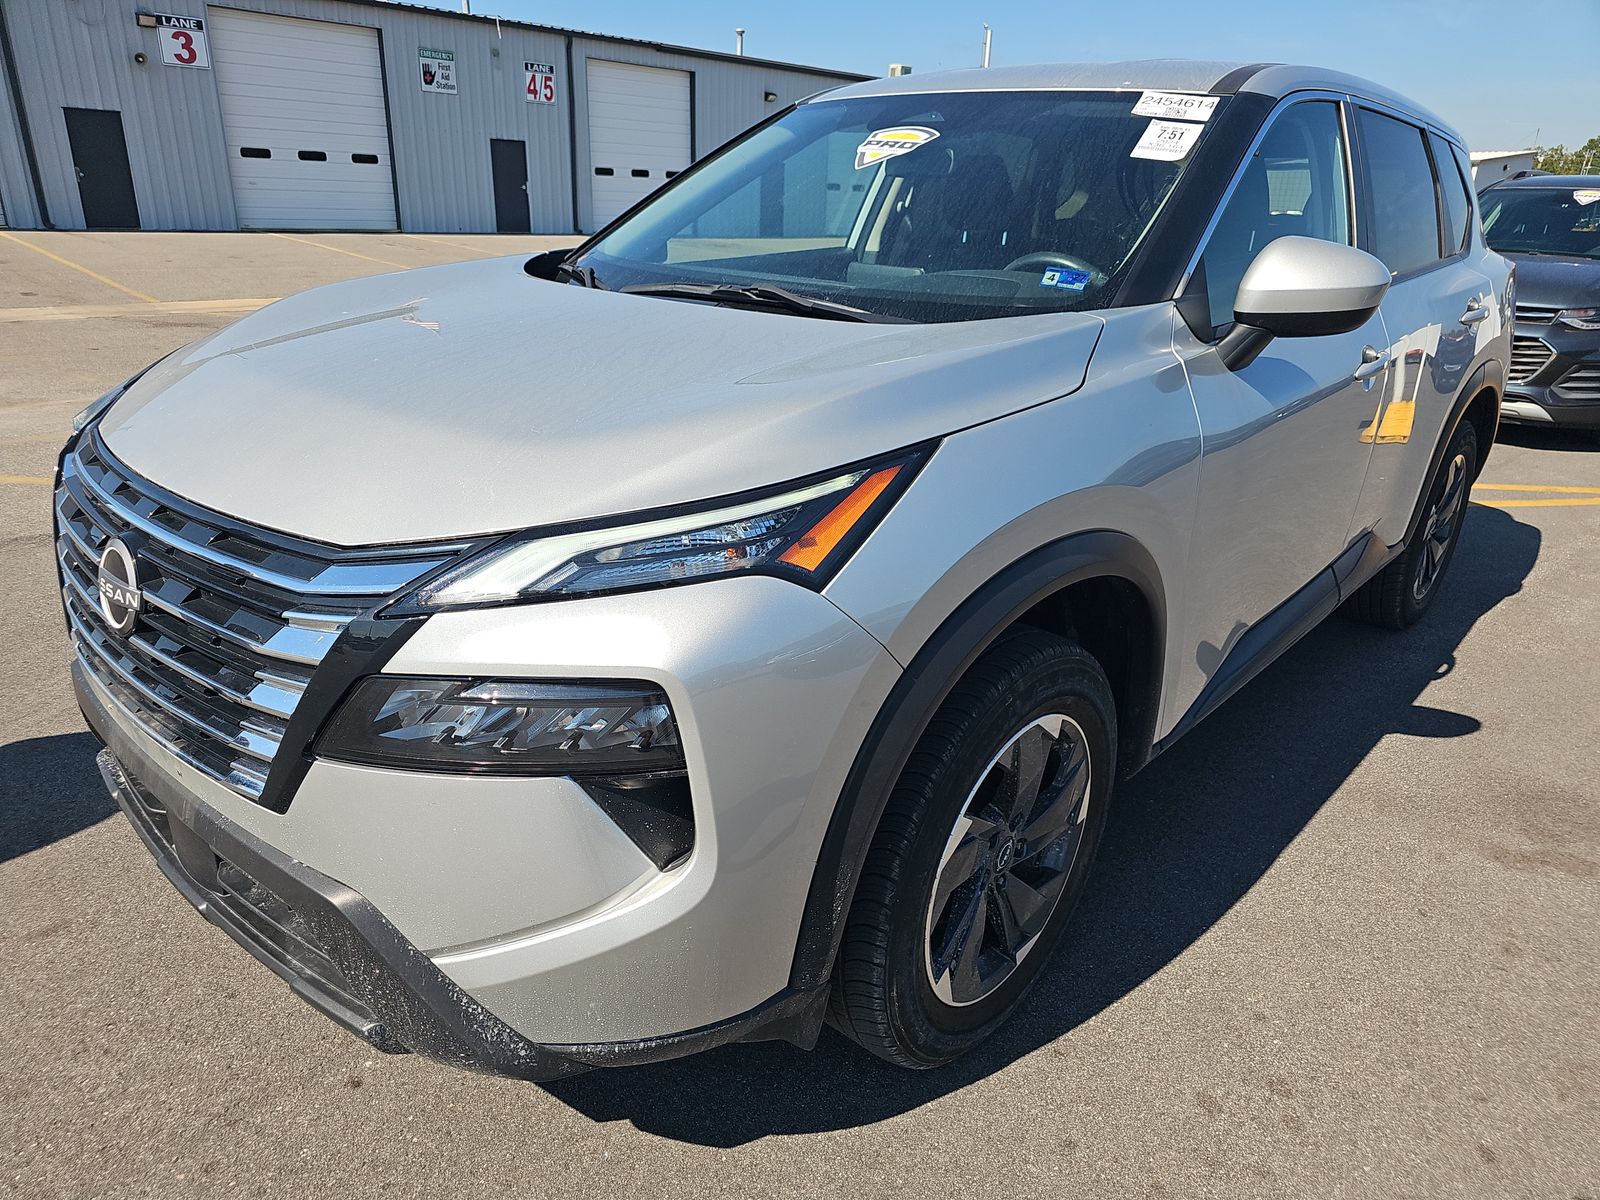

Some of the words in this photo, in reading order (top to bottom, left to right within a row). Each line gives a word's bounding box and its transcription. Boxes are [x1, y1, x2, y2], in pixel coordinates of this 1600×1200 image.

[161, 16, 198, 29] LANE
[171, 31, 197, 64] 3
[420, 50, 453, 60] EMERGENCY
[438, 62, 451, 71] First
[527, 63, 551, 73] LANE
[441, 72, 450, 80] Aid
[436, 81, 456, 90] Station
[527, 73, 554, 101] 4/5
[1141, 96, 1215, 109] 2454614
[1157, 129, 1184, 140] 7:51
[862, 140, 920, 149] PRO
[1045, 273, 1056, 282] 4
[99, 577, 138, 608] SSAN
